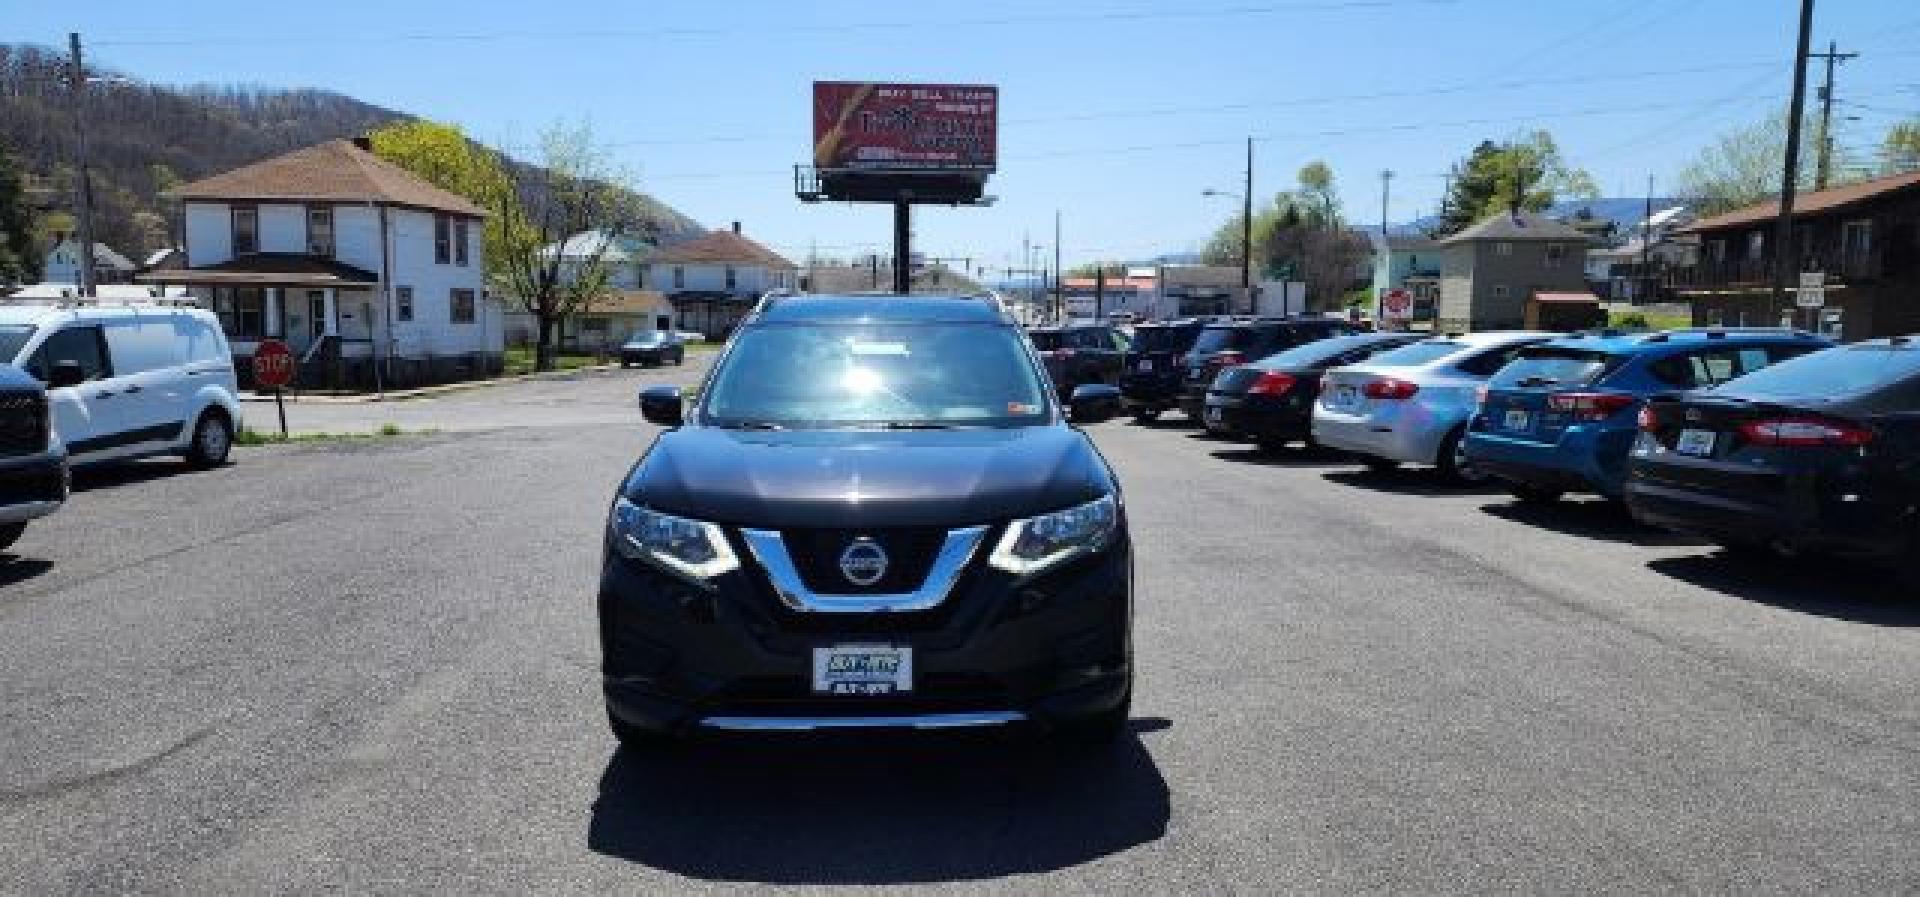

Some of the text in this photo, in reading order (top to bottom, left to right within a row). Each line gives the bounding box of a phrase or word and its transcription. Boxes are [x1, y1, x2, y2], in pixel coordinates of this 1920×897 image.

[878, 88, 907, 98] BUY
[911, 90, 943, 100] SELL
[254, 354, 295, 373] STOP
